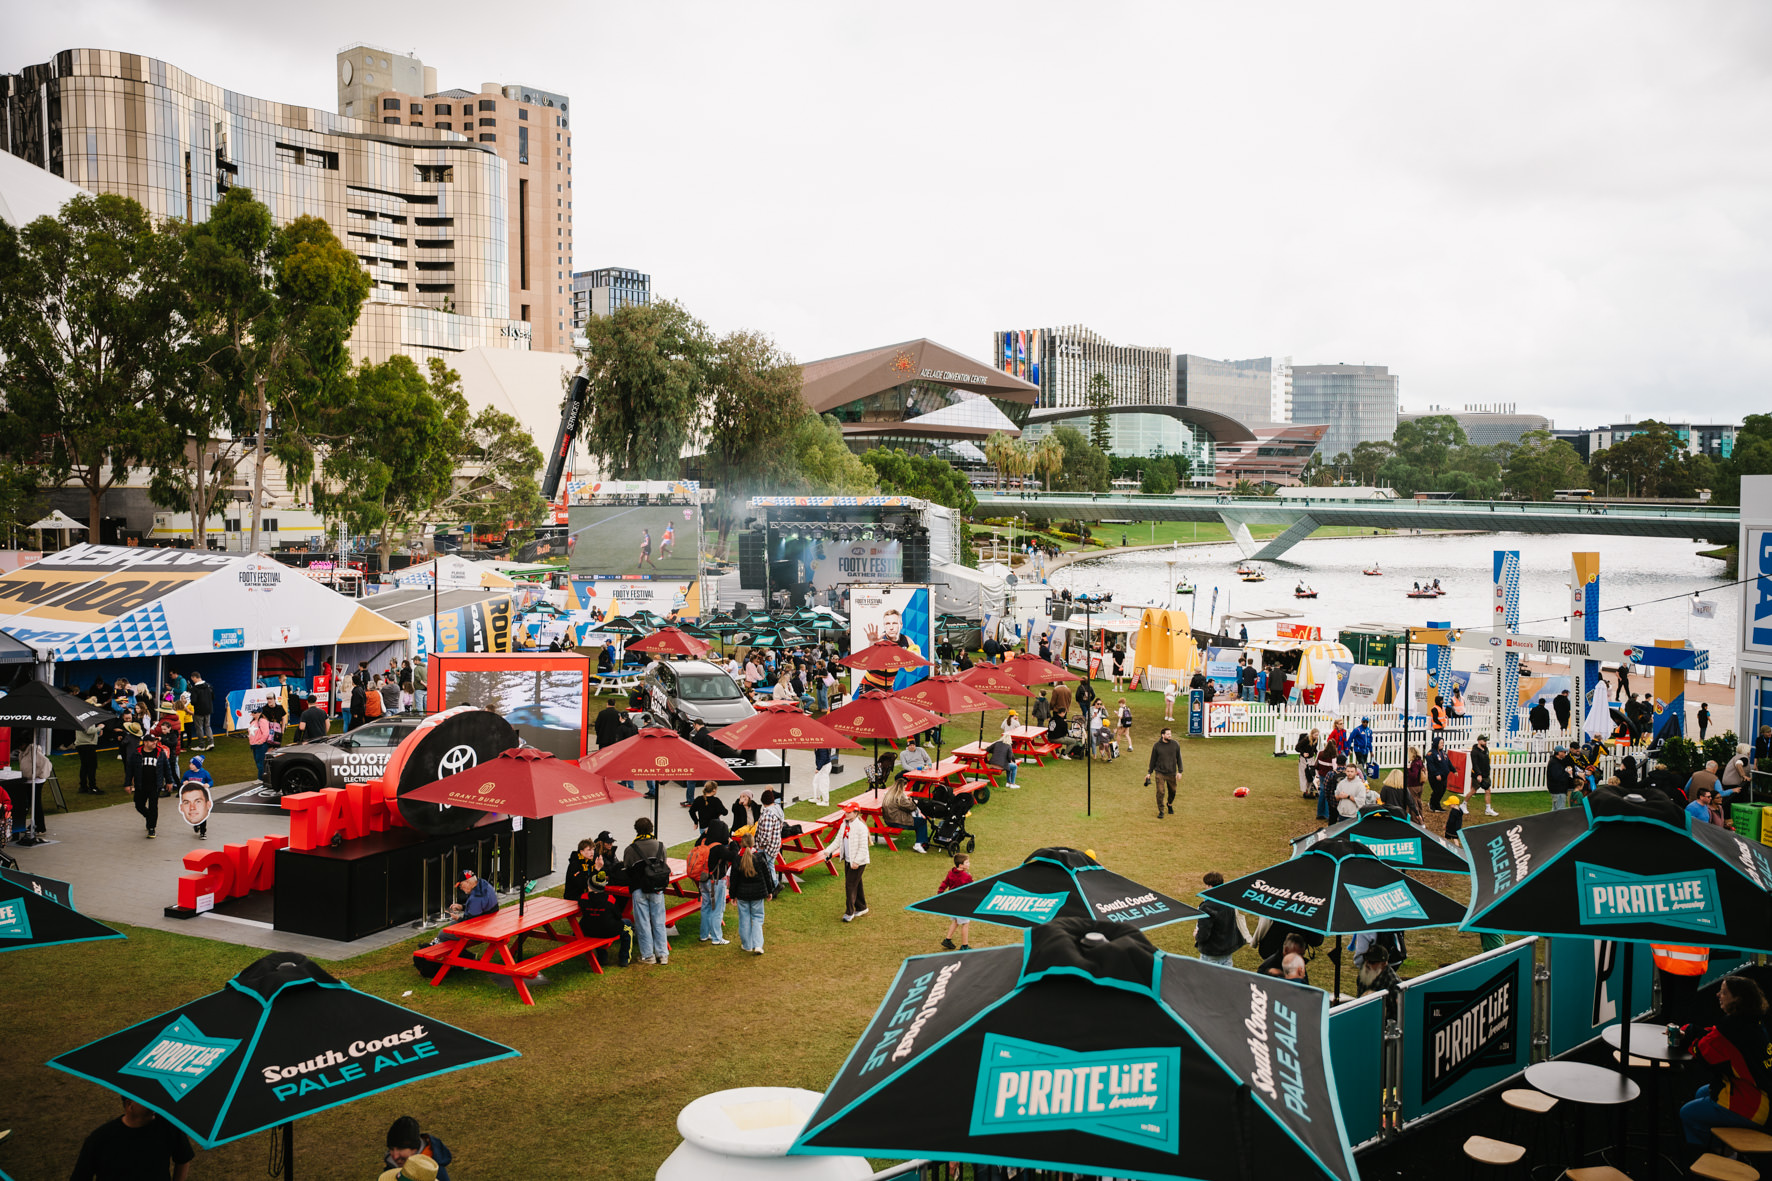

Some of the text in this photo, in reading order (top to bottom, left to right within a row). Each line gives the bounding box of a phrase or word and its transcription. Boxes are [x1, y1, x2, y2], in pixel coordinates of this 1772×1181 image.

[920, 368, 988, 385] ADELAIDE CONVENTION CENTRE
[838, 557, 868, 572] FOOTY
[239, 571, 281, 583] FOOTY FESTIVAL
[612, 589, 630, 598] FOOTY
[630, 589, 655, 599] FESTIVAL
[1490, 638, 1591, 657] AFL Macca's FOOTY FESTIVAL
[341, 753, 393, 765] TOYOTA
[448, 791, 477, 800] GRANT
[478, 796, 507, 805] BURGE
[1506, 824, 1529, 859] South
[1486, 835, 1512, 895] PALE ALE
[1095, 892, 1159, 914] South Coast
[1241, 888, 1319, 917] PALE ALE
[1251, 879, 1327, 906] South Coast
[1106, 901, 1171, 923] PALE ALE
[891, 960, 962, 1062] South Coast
[858, 970, 935, 1077] PALE ALE
[261, 1023, 430, 1084] South Coast
[1244, 982, 1278, 1101] South Coast
[271, 1040, 440, 1102] PALE ALE
[1273, 999, 1312, 1124] PALE ALE
[1108, 1093, 1159, 1111] brewing
